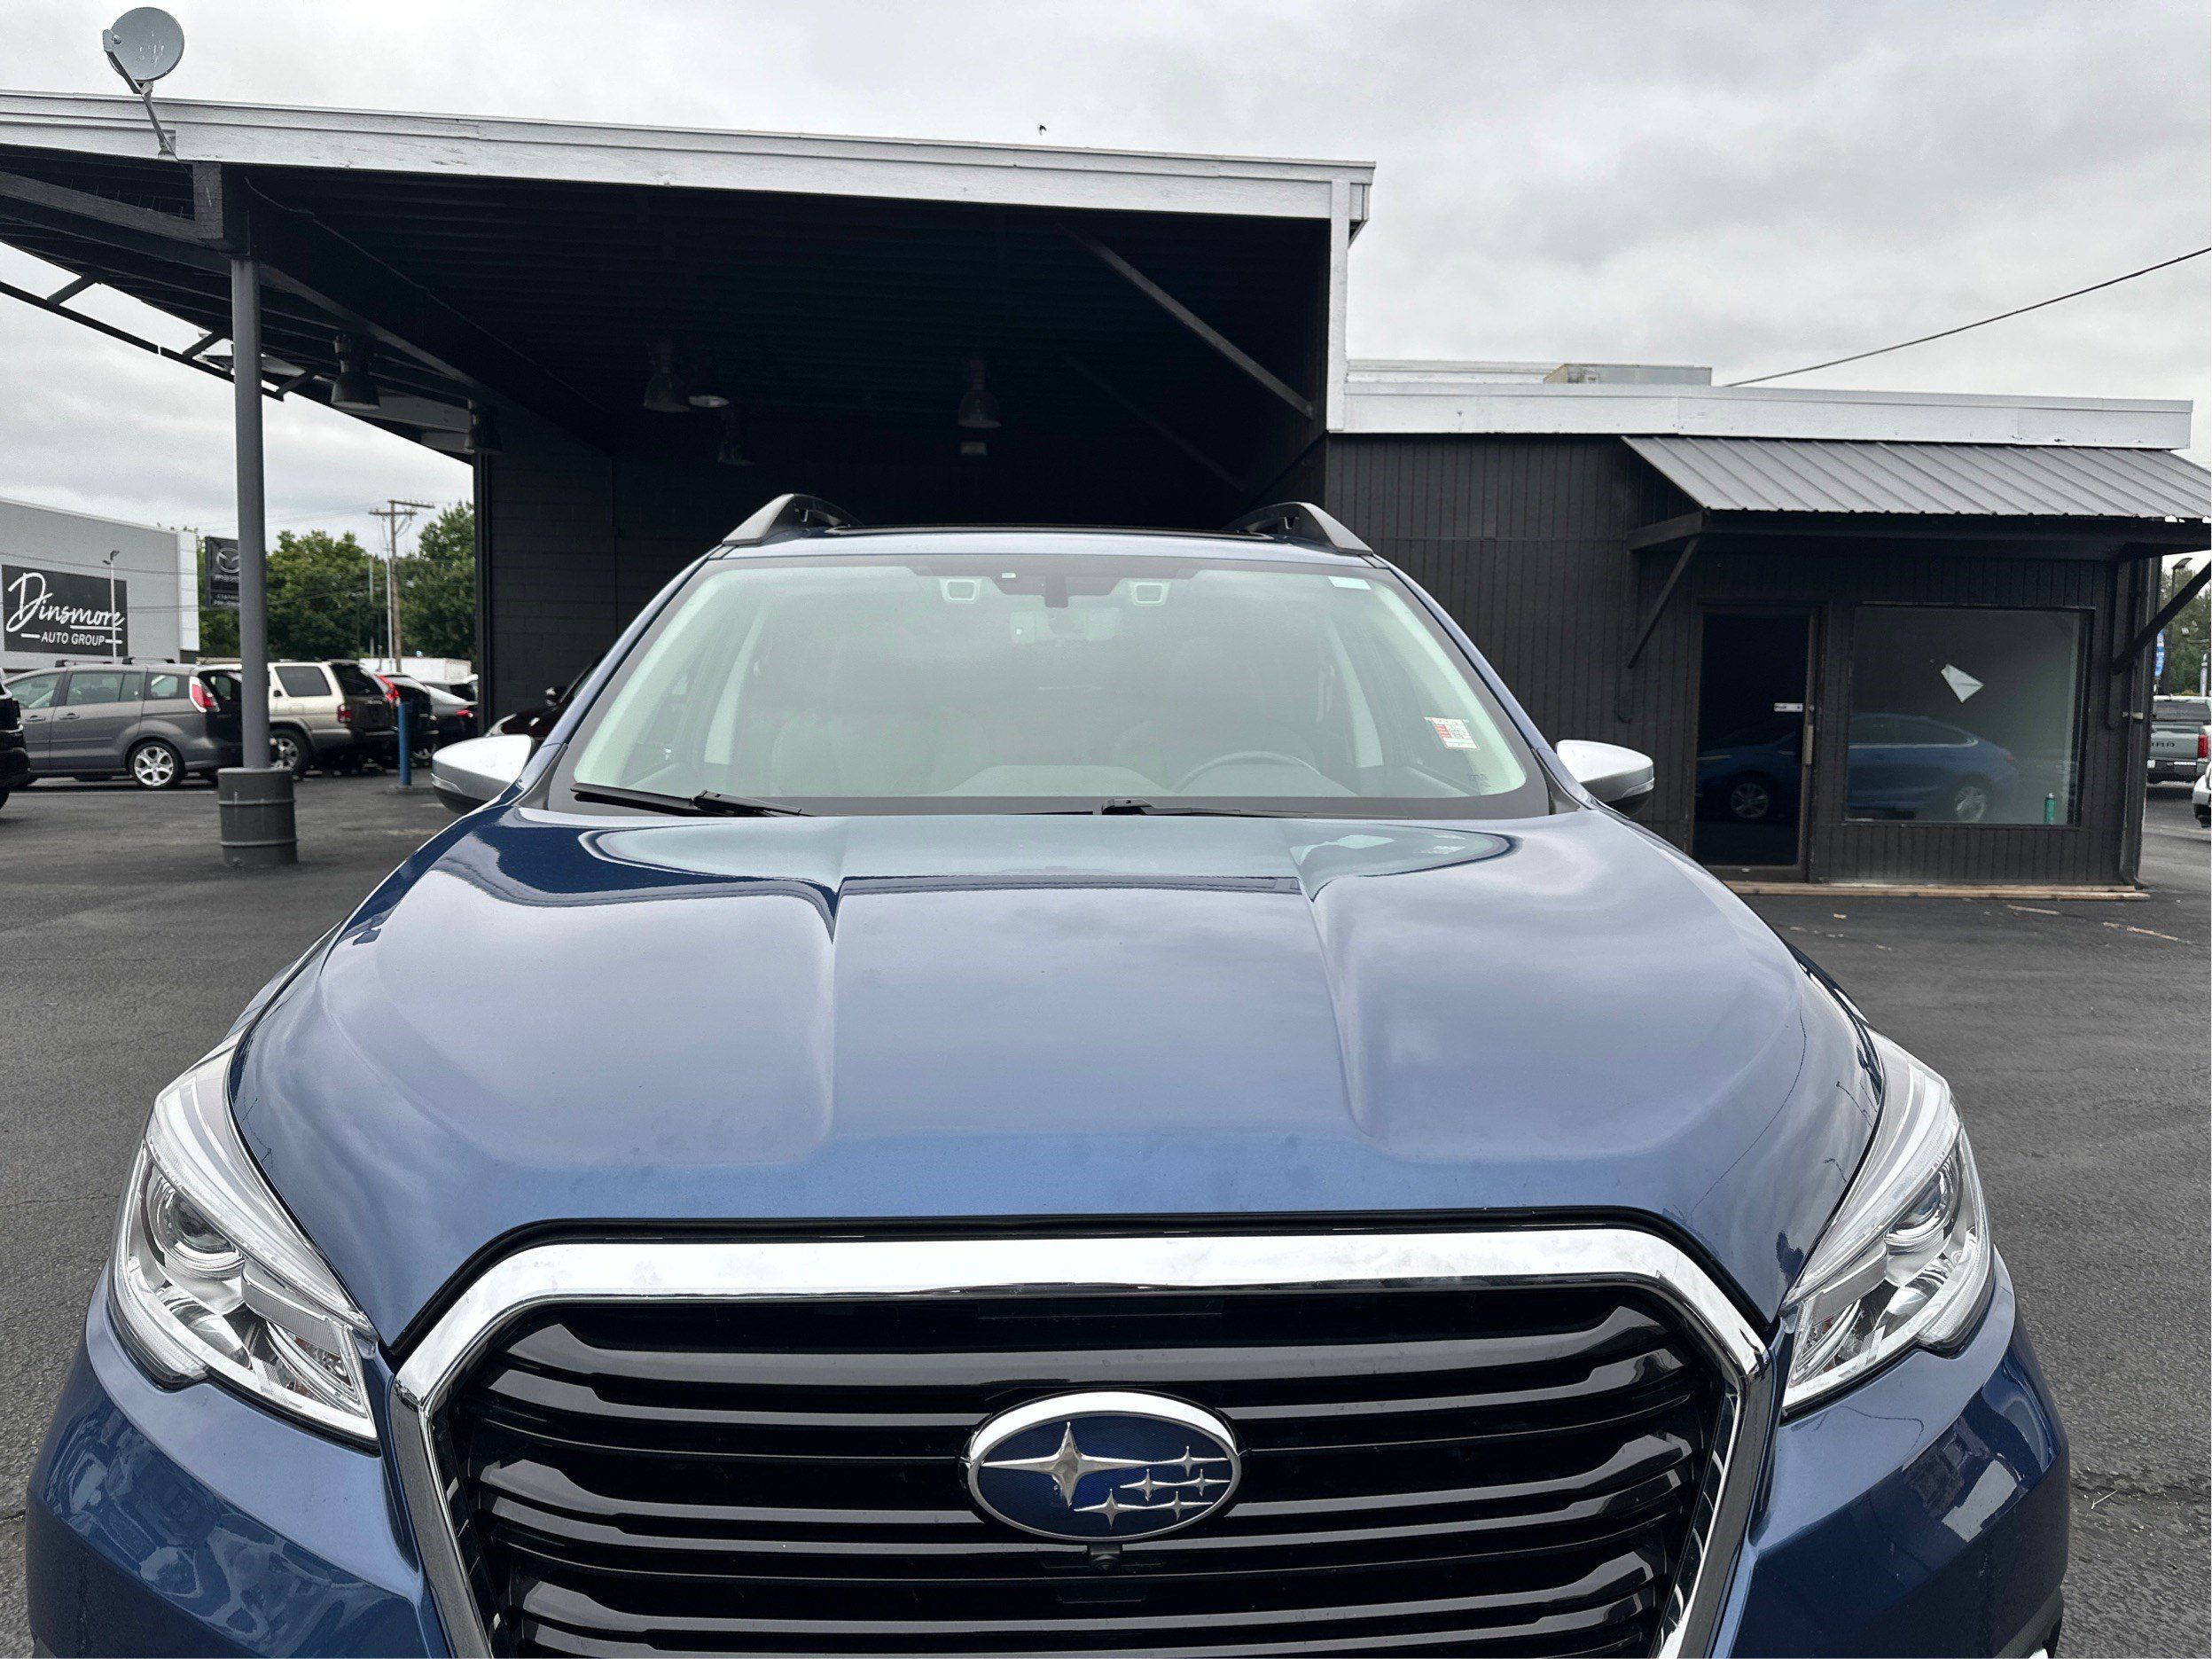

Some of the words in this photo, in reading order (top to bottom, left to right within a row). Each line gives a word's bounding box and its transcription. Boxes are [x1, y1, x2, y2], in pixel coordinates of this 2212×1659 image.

[6, 572, 125, 632] Dinsmore
[41, 631, 69, 645] AUTO
[71, 632, 106, 646] GROUP
